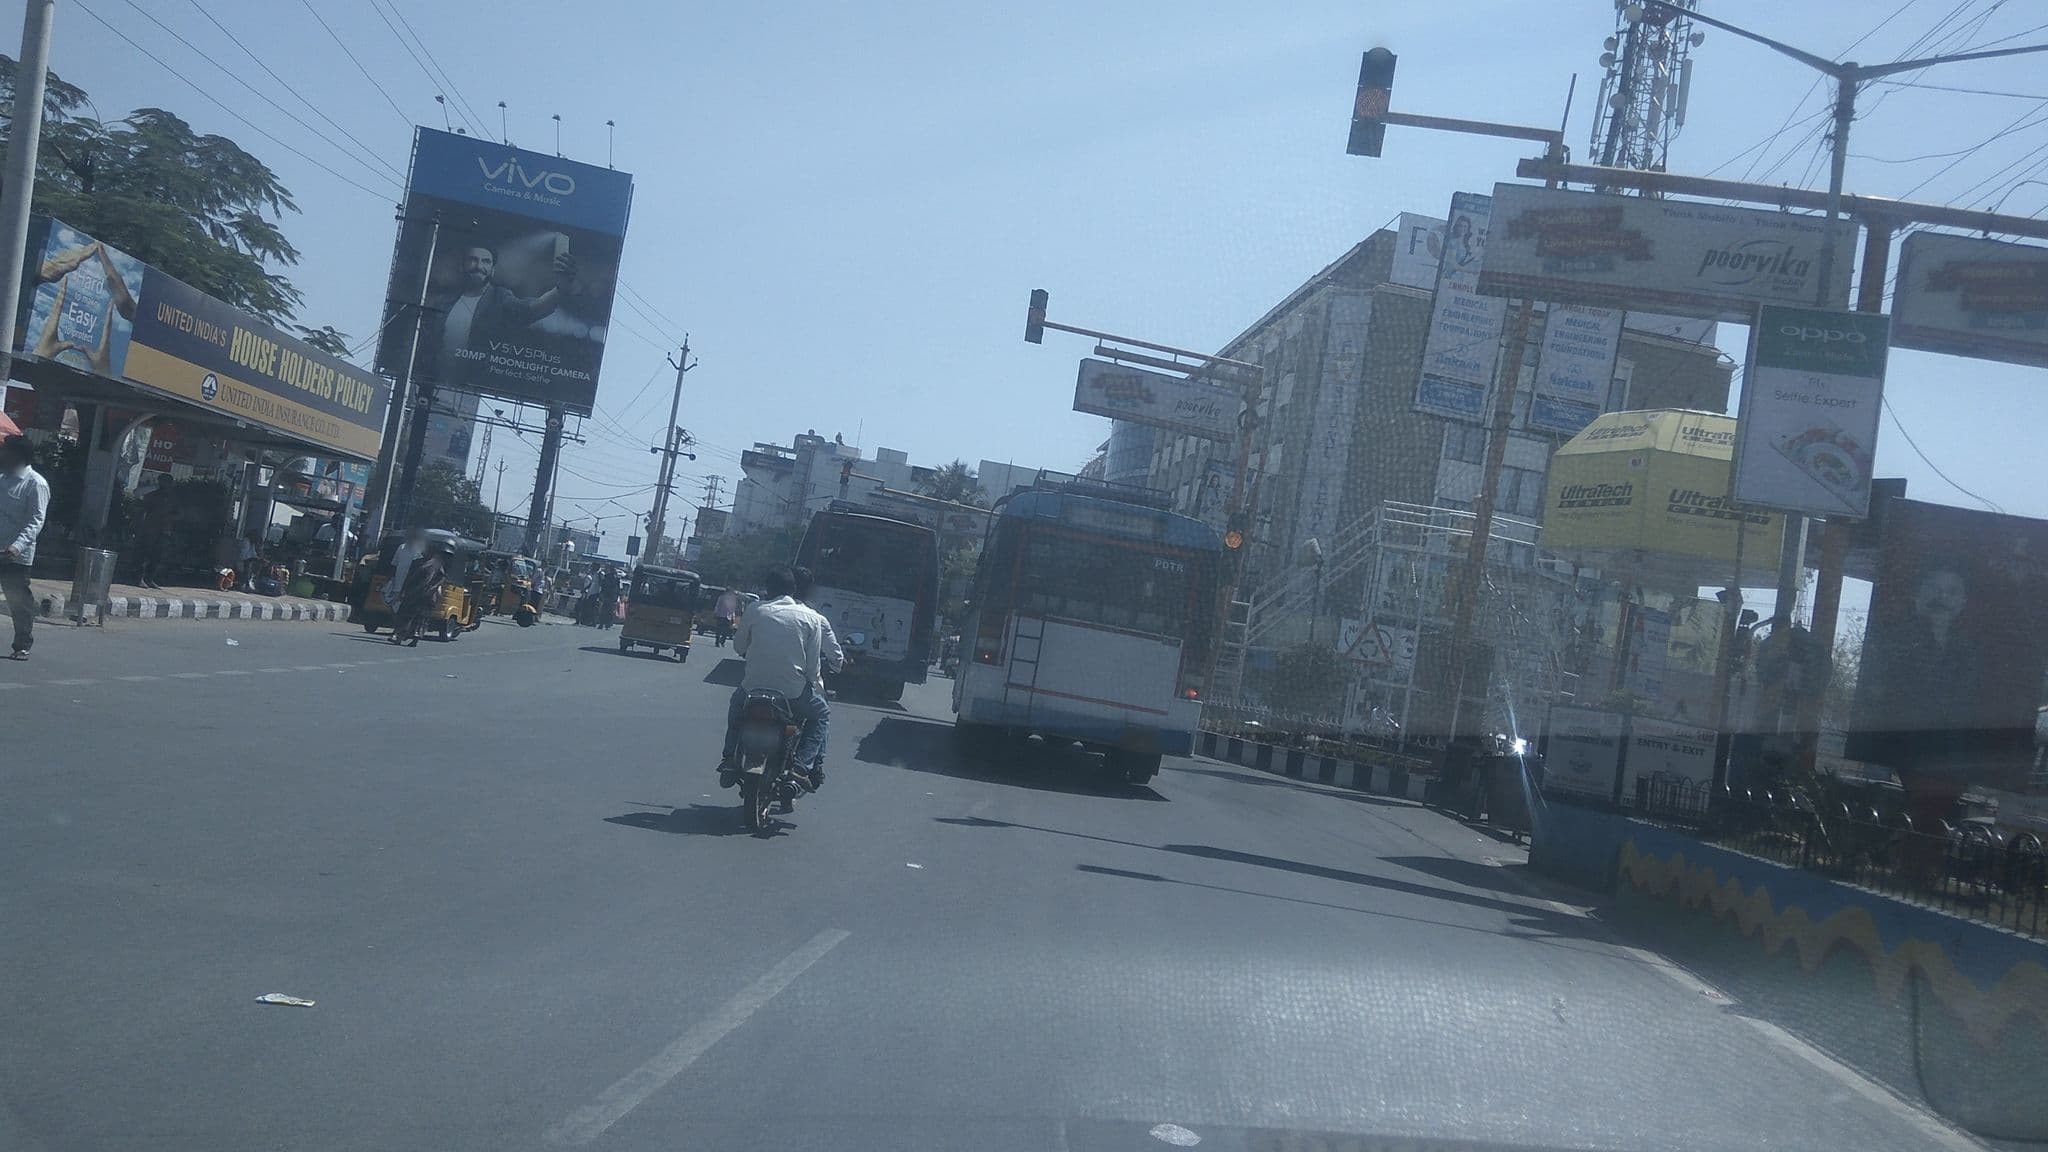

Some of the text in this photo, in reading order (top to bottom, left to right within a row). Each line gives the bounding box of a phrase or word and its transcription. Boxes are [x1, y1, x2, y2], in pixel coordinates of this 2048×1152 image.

[478, 157, 576, 195] vivo
[485, 183, 560, 207] Camera & Music
[1697, 245, 1813, 278] poorvika
[69, 301, 97, 333] Easy
[157, 302, 227, 348] UNITED INDIA'S
[230, 326, 374, 414] HOUSE HOLDERS POLICY
[455, 347, 592, 382] 20MP MOONLIGHT CAMERA
[489, 365, 522, 379] Perfect
[221, 384, 253, 412] UNITED
[253, 395, 275, 419] INDIA
[274, 402, 318, 434] INSURANCE
[1775, 390, 1857, 409] Selfie Expert
[1561, 482, 1633, 500] UltraTech
[1638, 737, 1669, 751] ENTRY
[1682, 745, 1706, 757] EXIT
